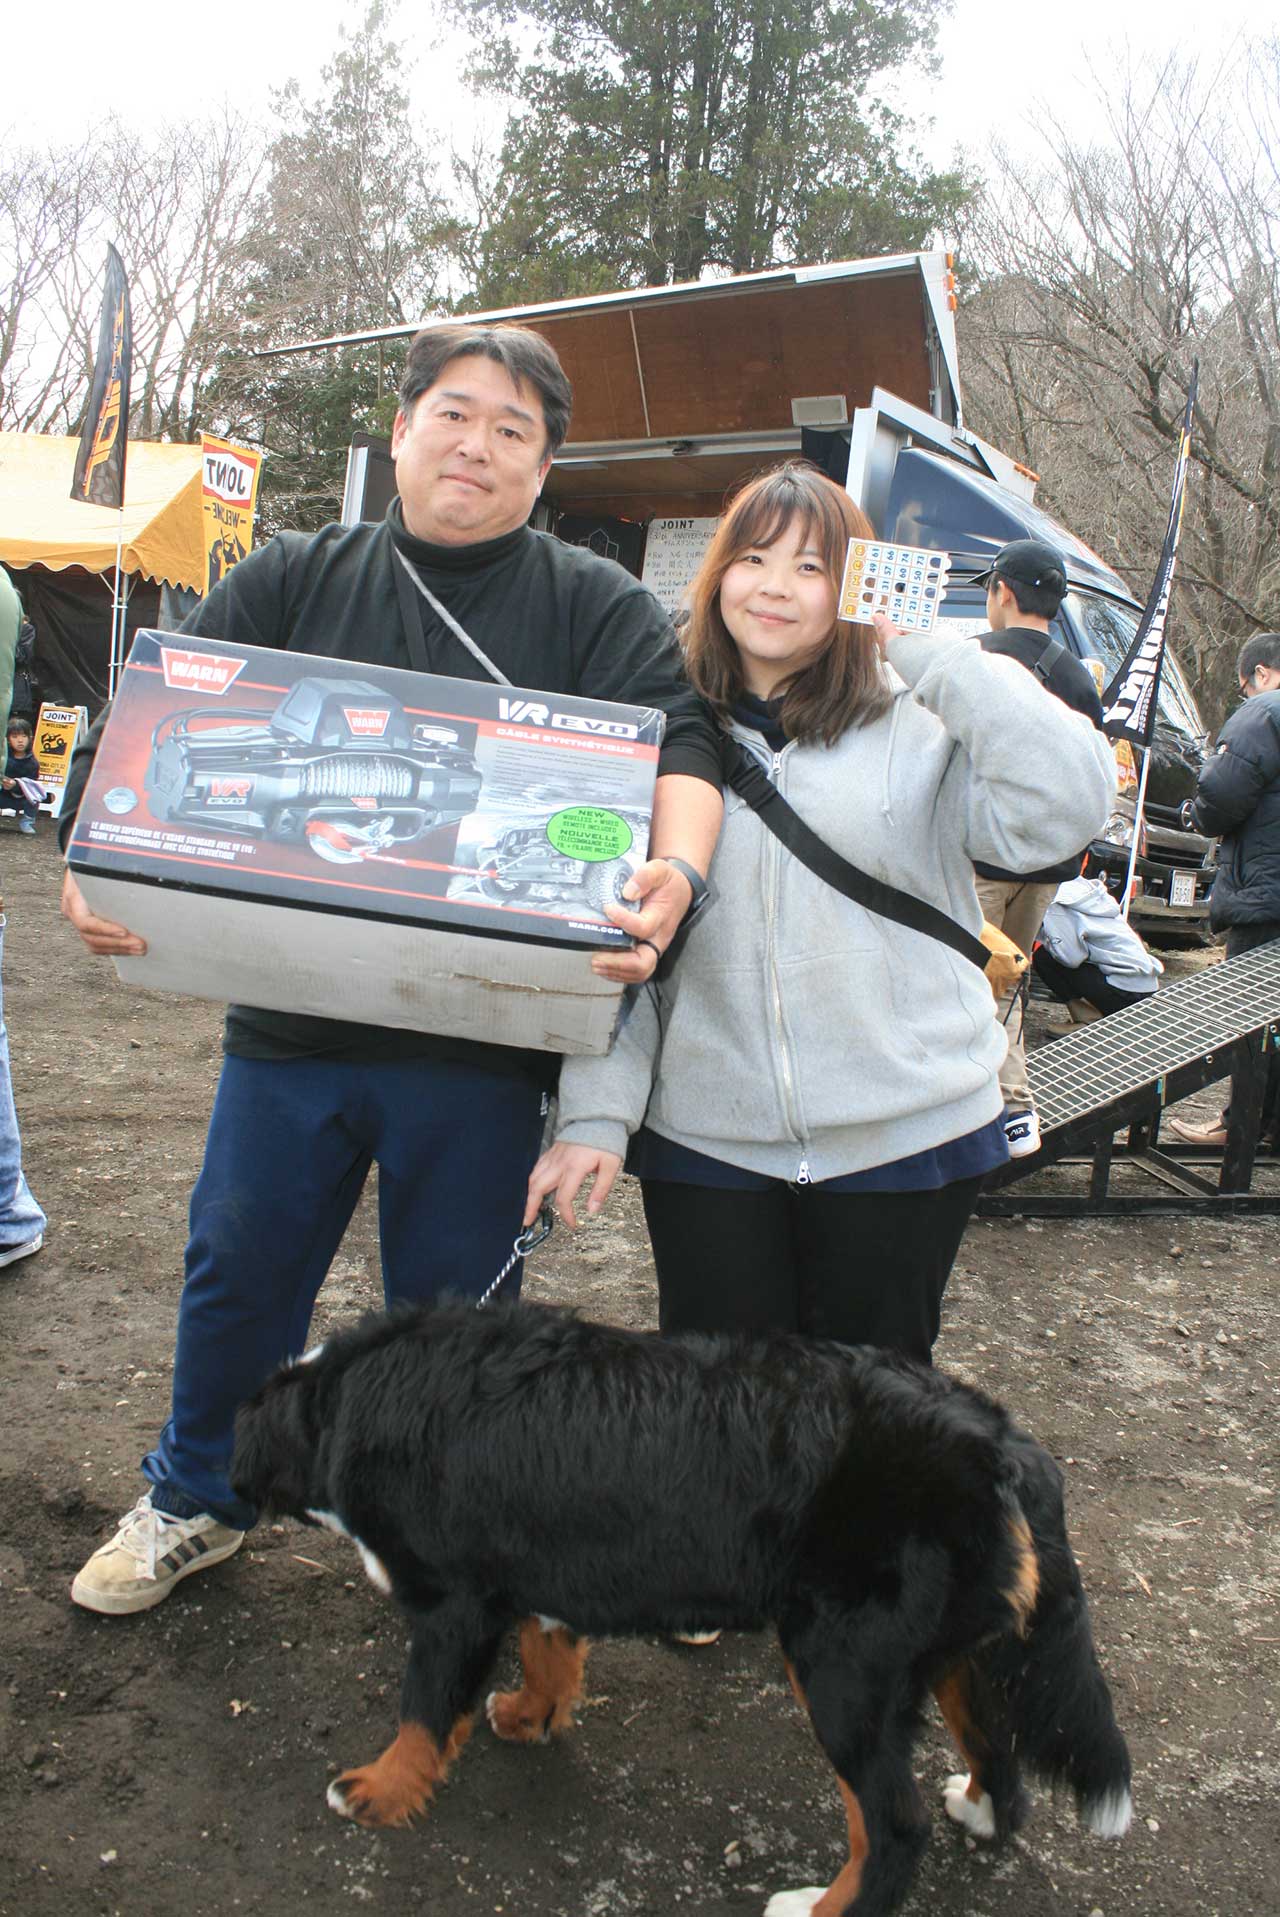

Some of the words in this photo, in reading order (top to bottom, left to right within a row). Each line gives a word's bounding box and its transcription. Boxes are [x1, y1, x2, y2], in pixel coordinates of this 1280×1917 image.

[661, 520, 694, 529] JOINT
[872, 548, 880, 557] 61
[887, 551, 894, 560] 66
[901, 553, 909, 562] 74
[917, 556, 924, 565] 73
[869, 563, 877, 573] 49
[884, 566, 892, 575] 57
[900, 568, 907, 578] 60
[914, 570, 922, 580] 50
[882, 581, 889, 590] 31
[912, 586, 919, 595] 41
[894, 598, 902, 607] 24
[924, 604, 932, 613] 19
[921, 619, 929, 628] 12
[171, 661, 228, 683] WARN
[46, 712, 72, 721] JOINT
[499, 698, 549, 726] VR
[560, 717, 629, 735] EVO
[352, 718, 383, 728] WARN
[560, 830, 618, 842] NOUVELLE
[568, 922, 623, 935] WARN.COM
[1010, 1127, 1025, 1136] AIR
